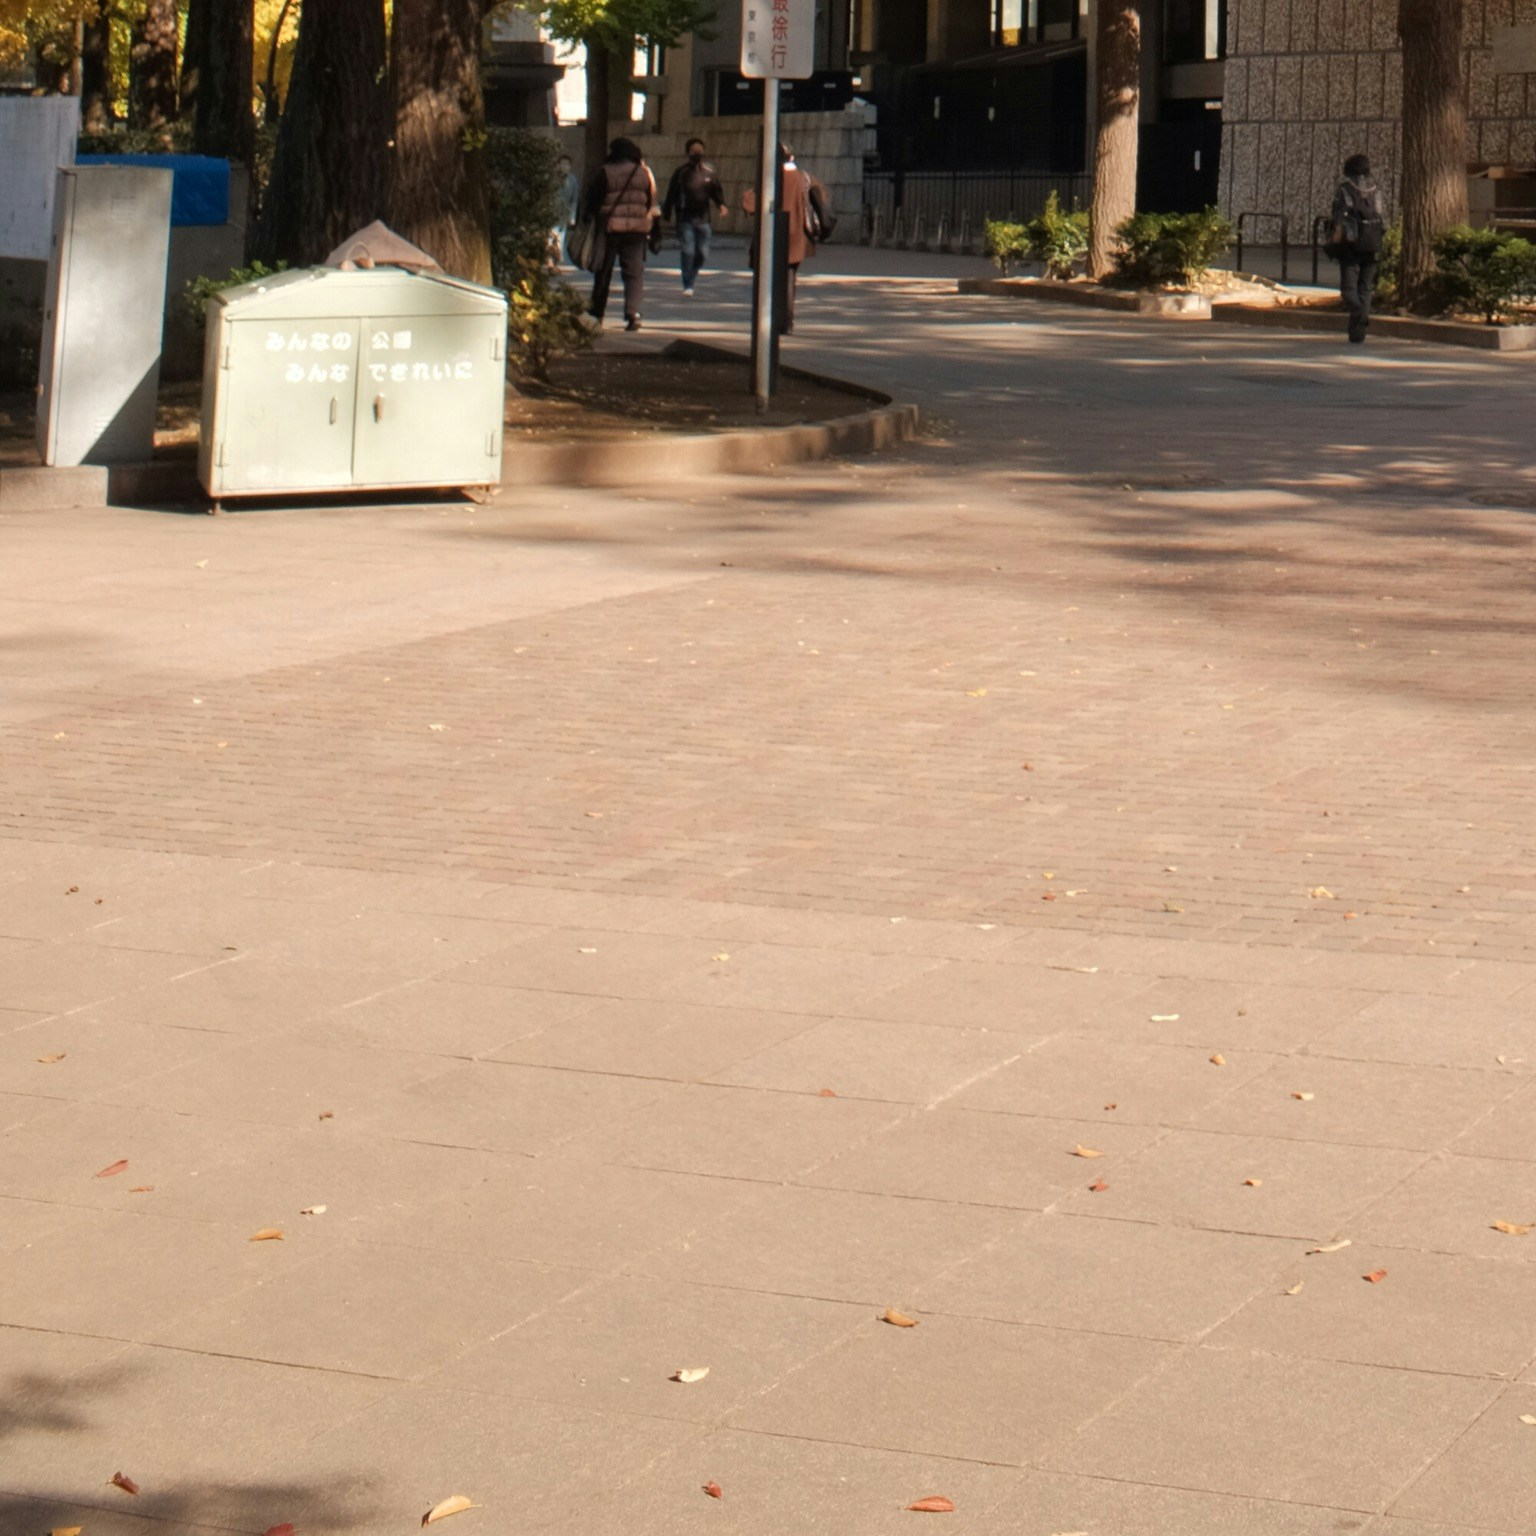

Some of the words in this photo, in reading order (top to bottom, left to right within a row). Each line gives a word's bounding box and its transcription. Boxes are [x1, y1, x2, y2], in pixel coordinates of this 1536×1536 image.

[265, 331, 352, 352] みんなの
[285, 362, 349, 383] みんな
